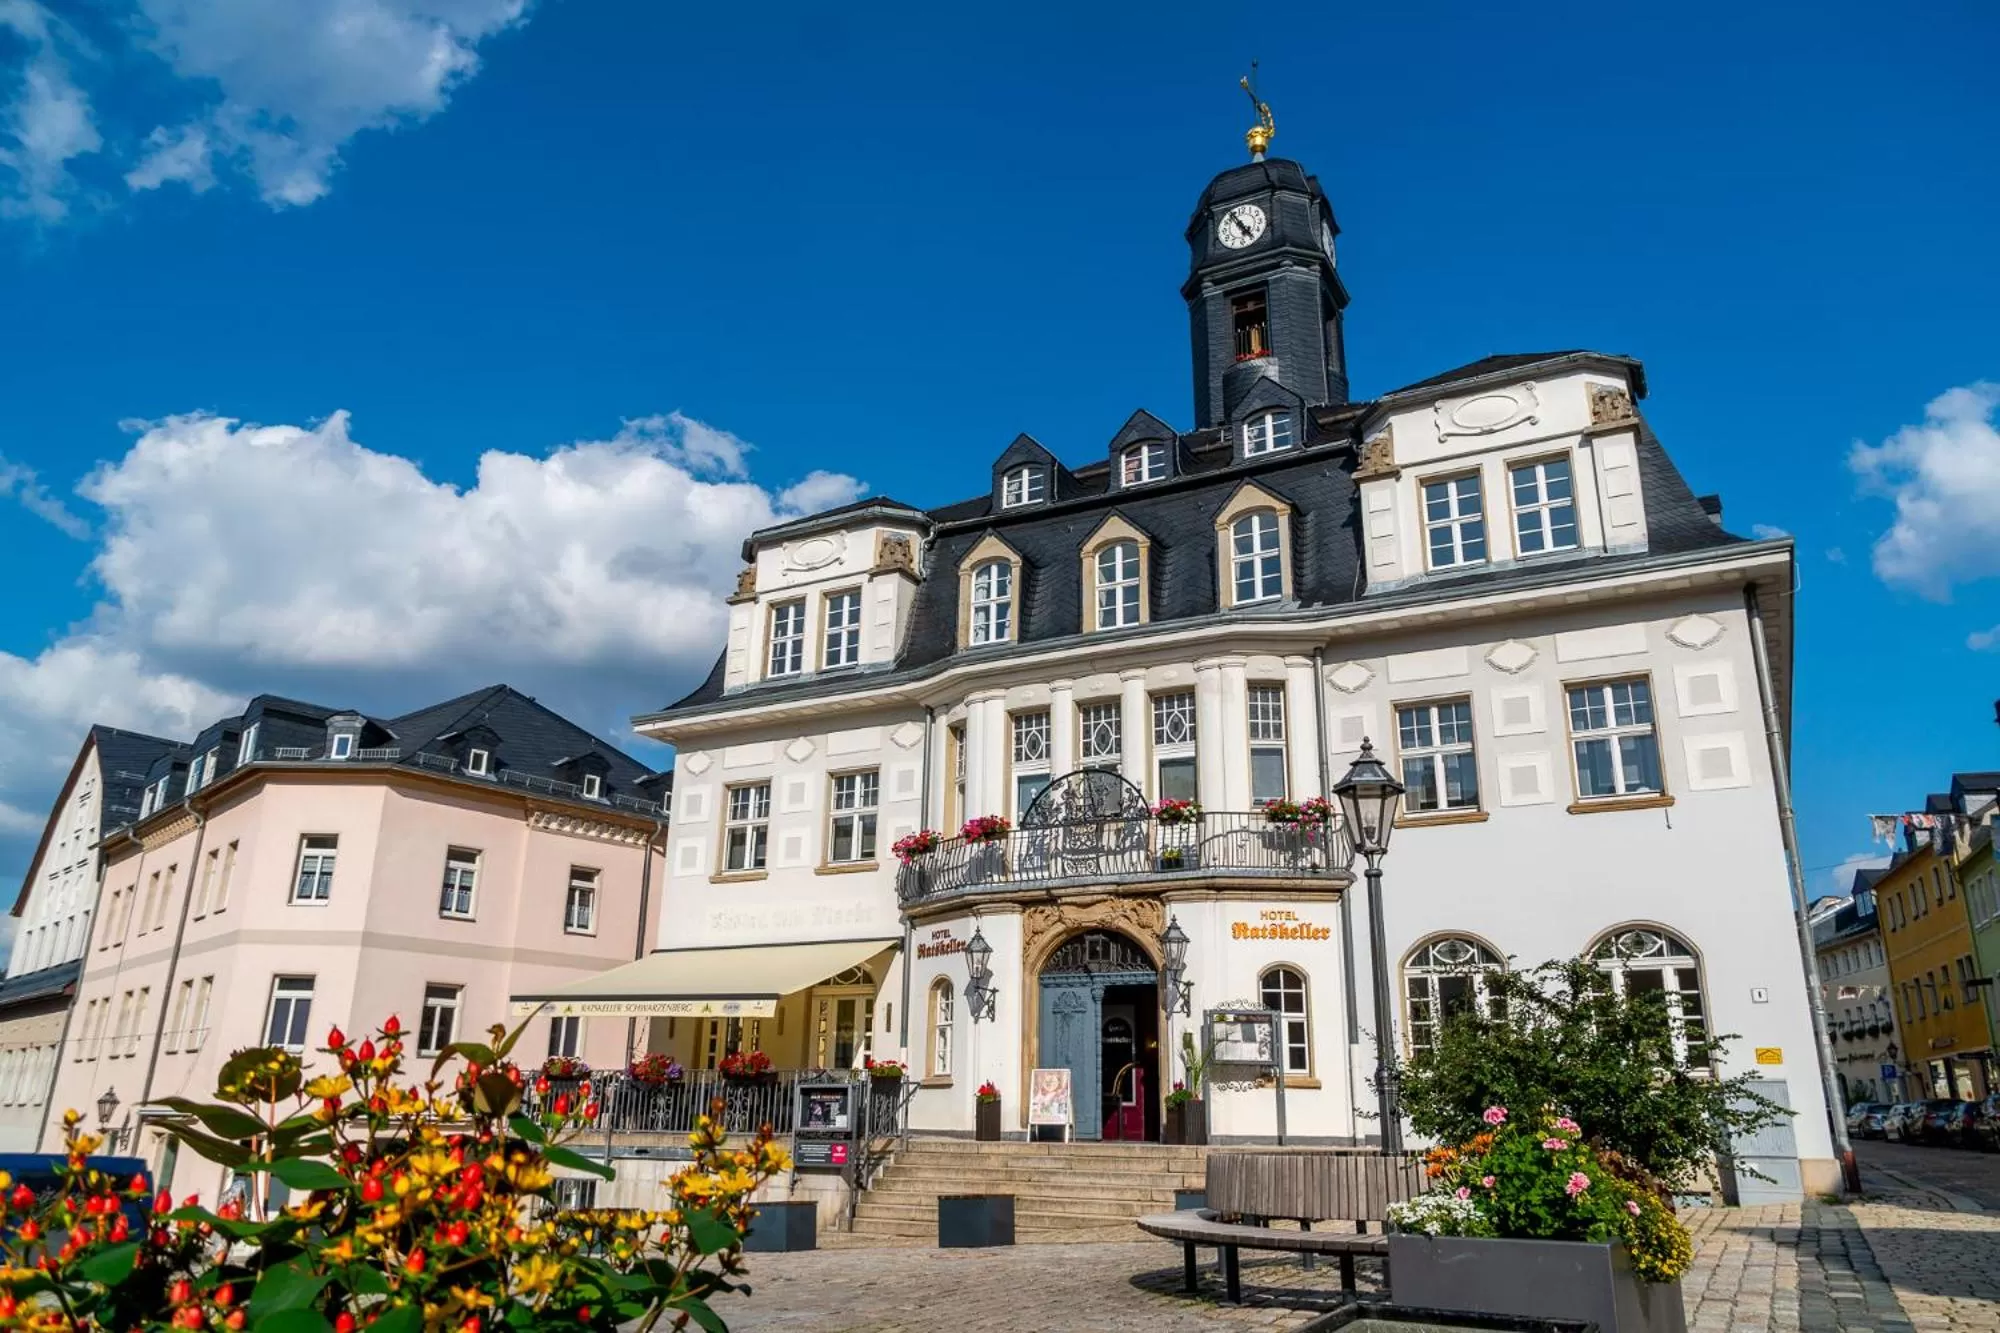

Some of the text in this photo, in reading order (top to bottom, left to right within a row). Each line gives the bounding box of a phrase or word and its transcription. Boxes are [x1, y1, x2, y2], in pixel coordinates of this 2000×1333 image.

[1238, 207, 1246, 216] 12
[1260, 909, 1299, 921] HOTEL
[931, 929, 951, 940] HOTEL
[1231, 921, 1331, 940] Ratskeller
[624, 1003, 693, 1013] SCHWARZENBERG
[1884, 1066, 1893, 1077] P
